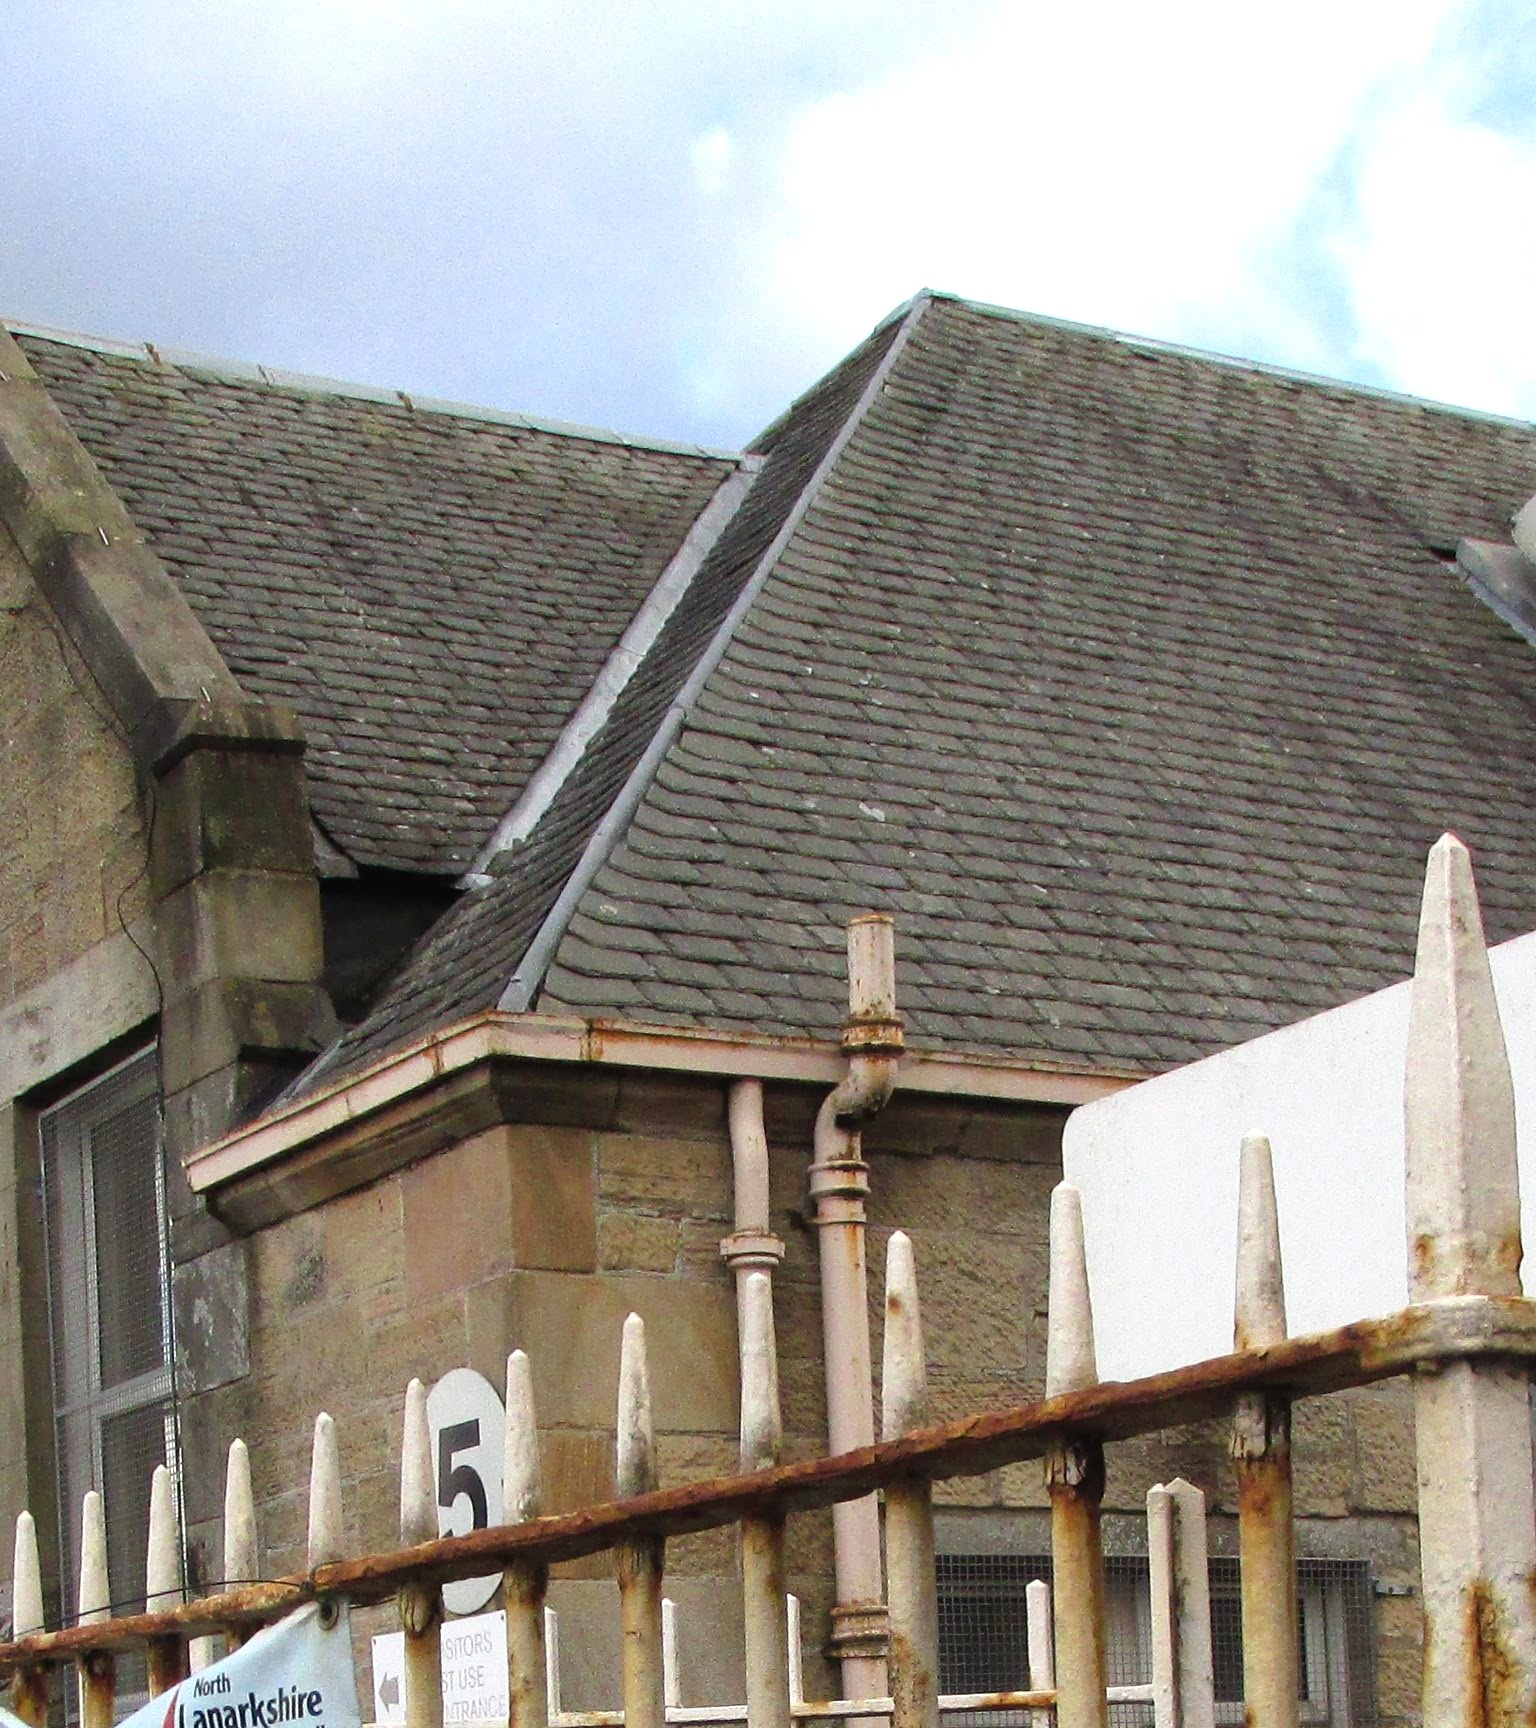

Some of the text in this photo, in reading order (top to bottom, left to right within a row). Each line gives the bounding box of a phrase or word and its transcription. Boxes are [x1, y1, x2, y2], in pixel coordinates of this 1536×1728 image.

[437, 1418, 488, 1538] 5
[193, 1672, 231, 1698] North
[458, 1665, 485, 1690] USE
[444, 1695, 507, 1721] NTRANCE
